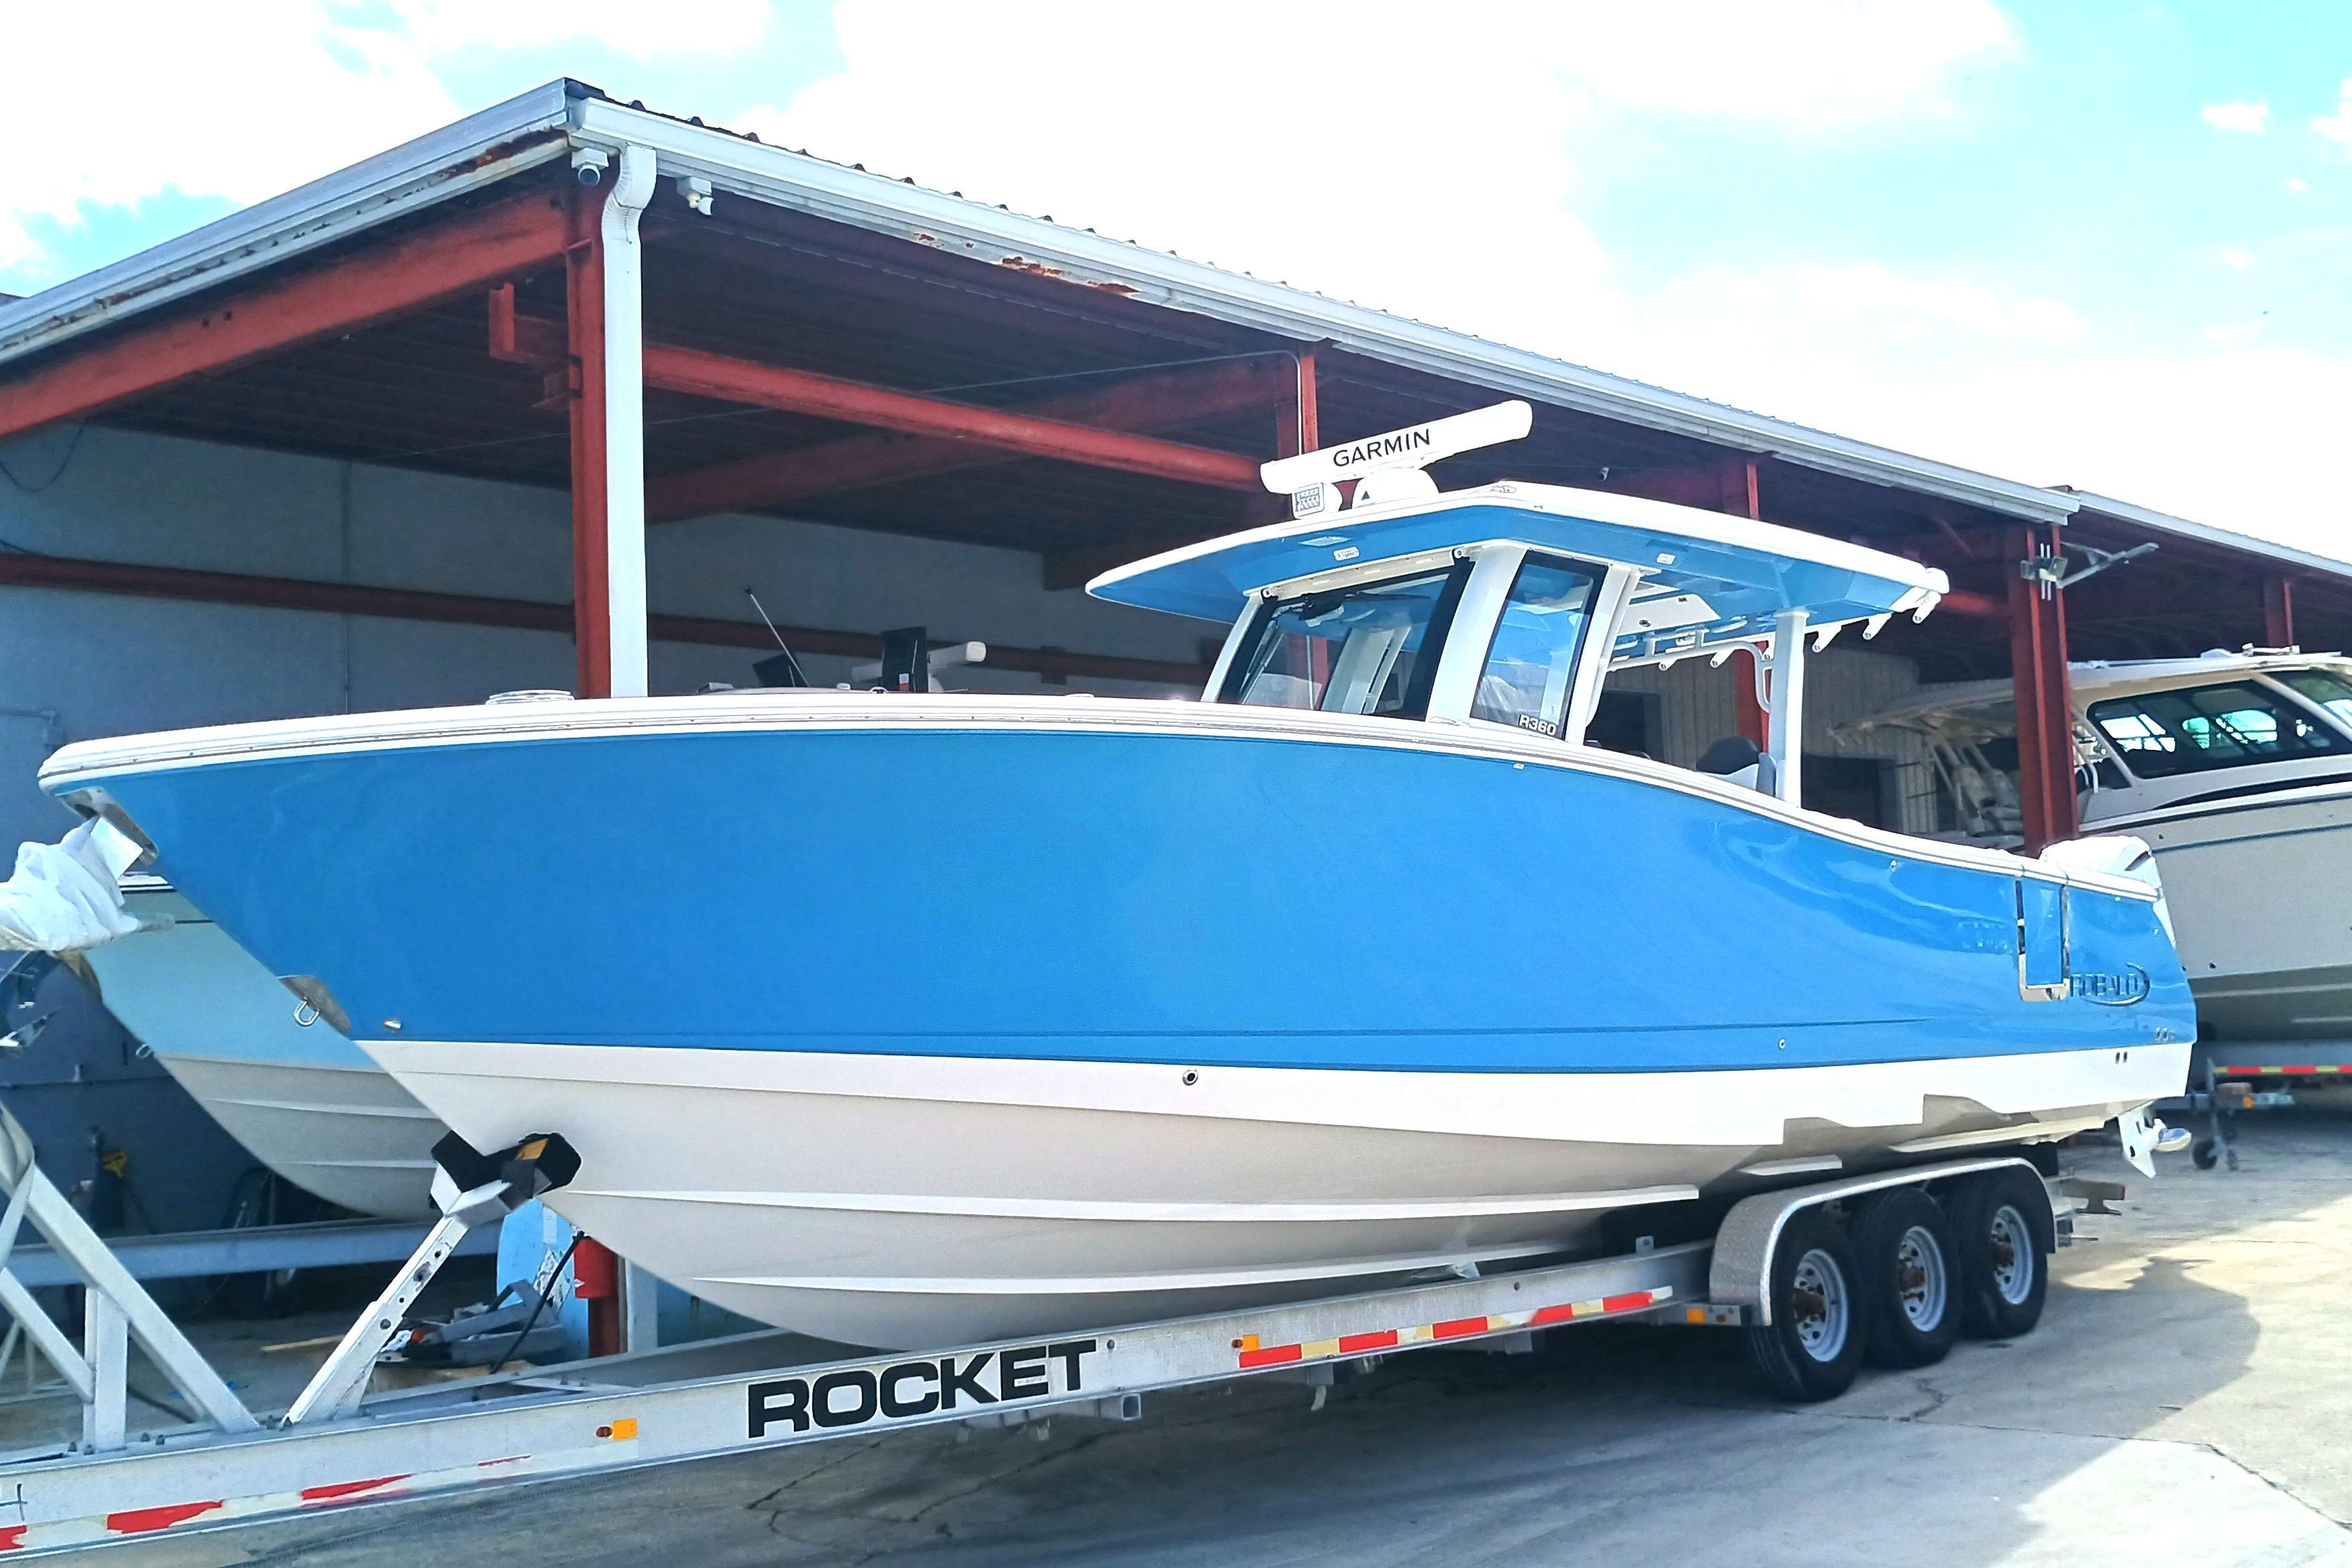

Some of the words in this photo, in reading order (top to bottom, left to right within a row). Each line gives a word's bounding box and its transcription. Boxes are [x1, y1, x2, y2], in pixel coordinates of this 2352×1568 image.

[1333, 429, 1431, 467] GARMIN
[1519, 715, 1556, 735] R360
[748, 1339, 1097, 1439] ROCKET
